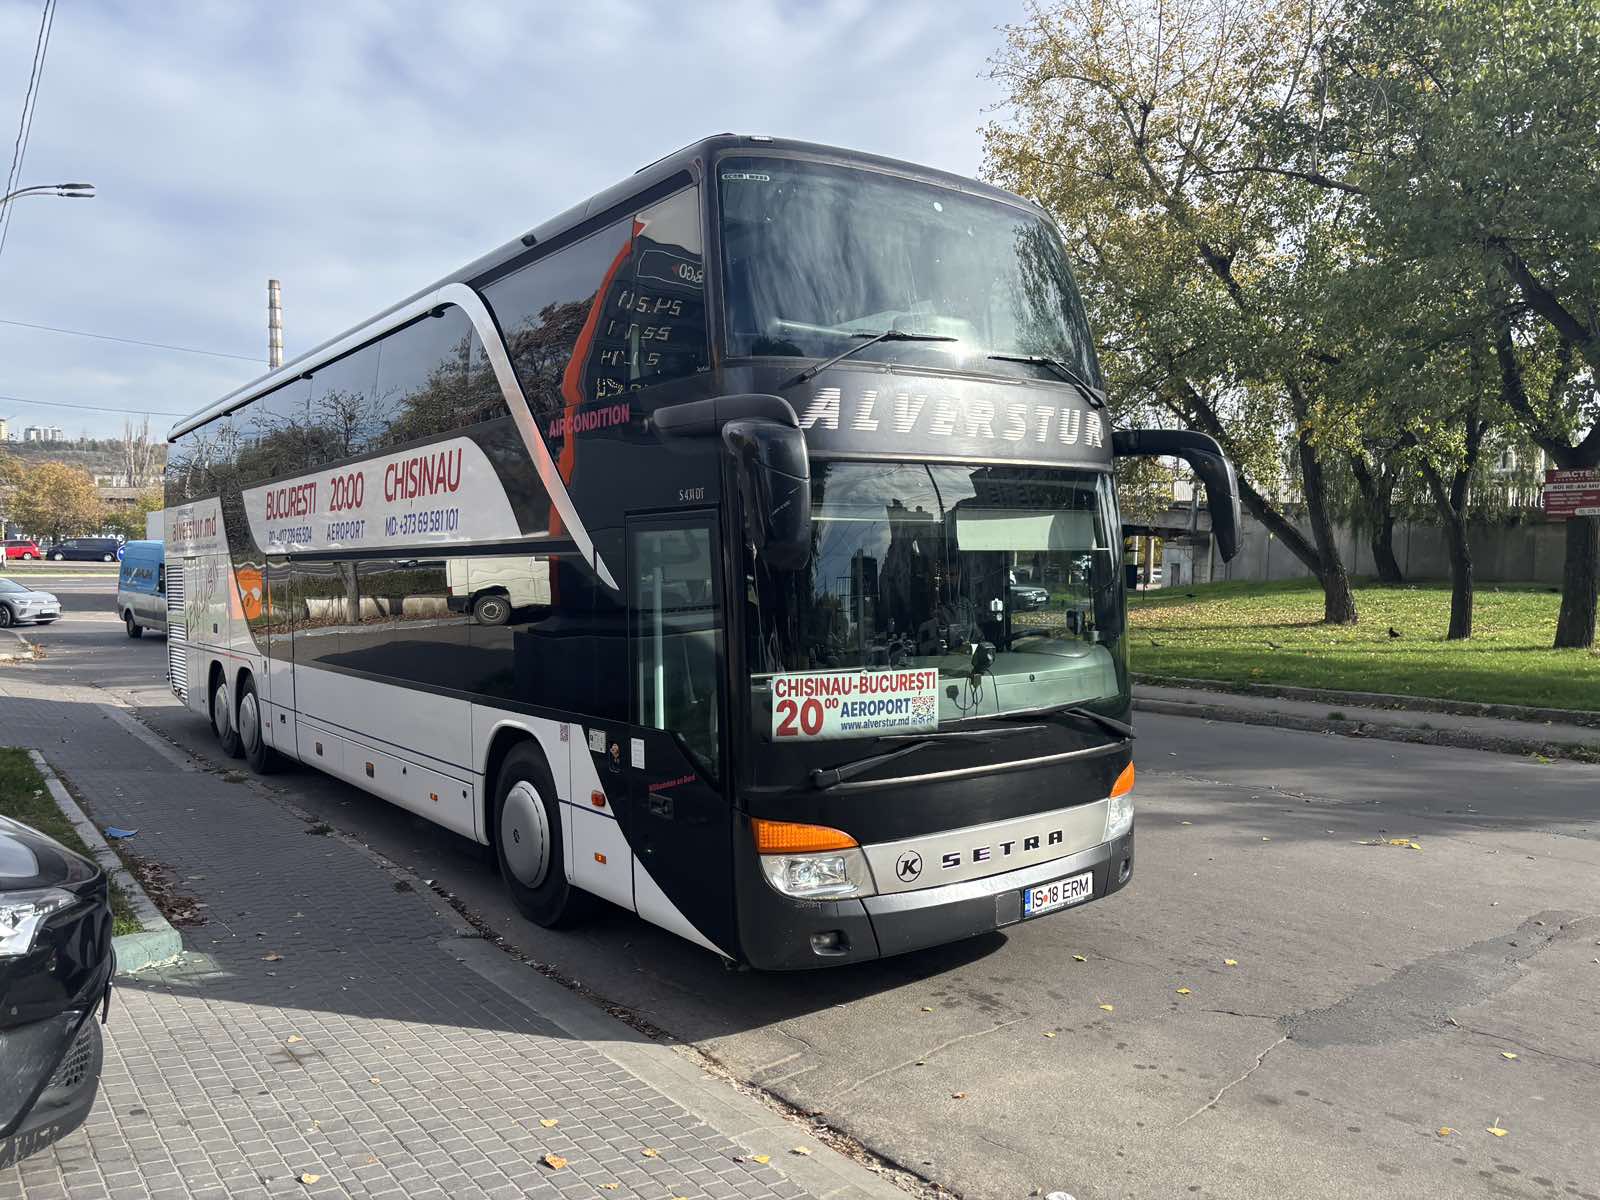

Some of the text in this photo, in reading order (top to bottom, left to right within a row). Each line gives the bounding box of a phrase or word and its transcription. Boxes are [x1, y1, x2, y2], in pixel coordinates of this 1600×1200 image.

[799, 387, 1103, 448] ALVERSTUR
[329, 471, 364, 511] 20:00
[326, 520, 365, 541] AEROPORT
[399, 513, 417, 535] +373
[417, 511, 429, 533] 69
[429, 509, 444, 532] 581
[840, 697, 911, 718] AEROPORT
[840, 715, 911, 731] www.alverstur.md
[942, 830, 1063, 868] SETRA
[1048, 886, 1059, 904] 18
[1063, 877, 1089, 900] ERM
